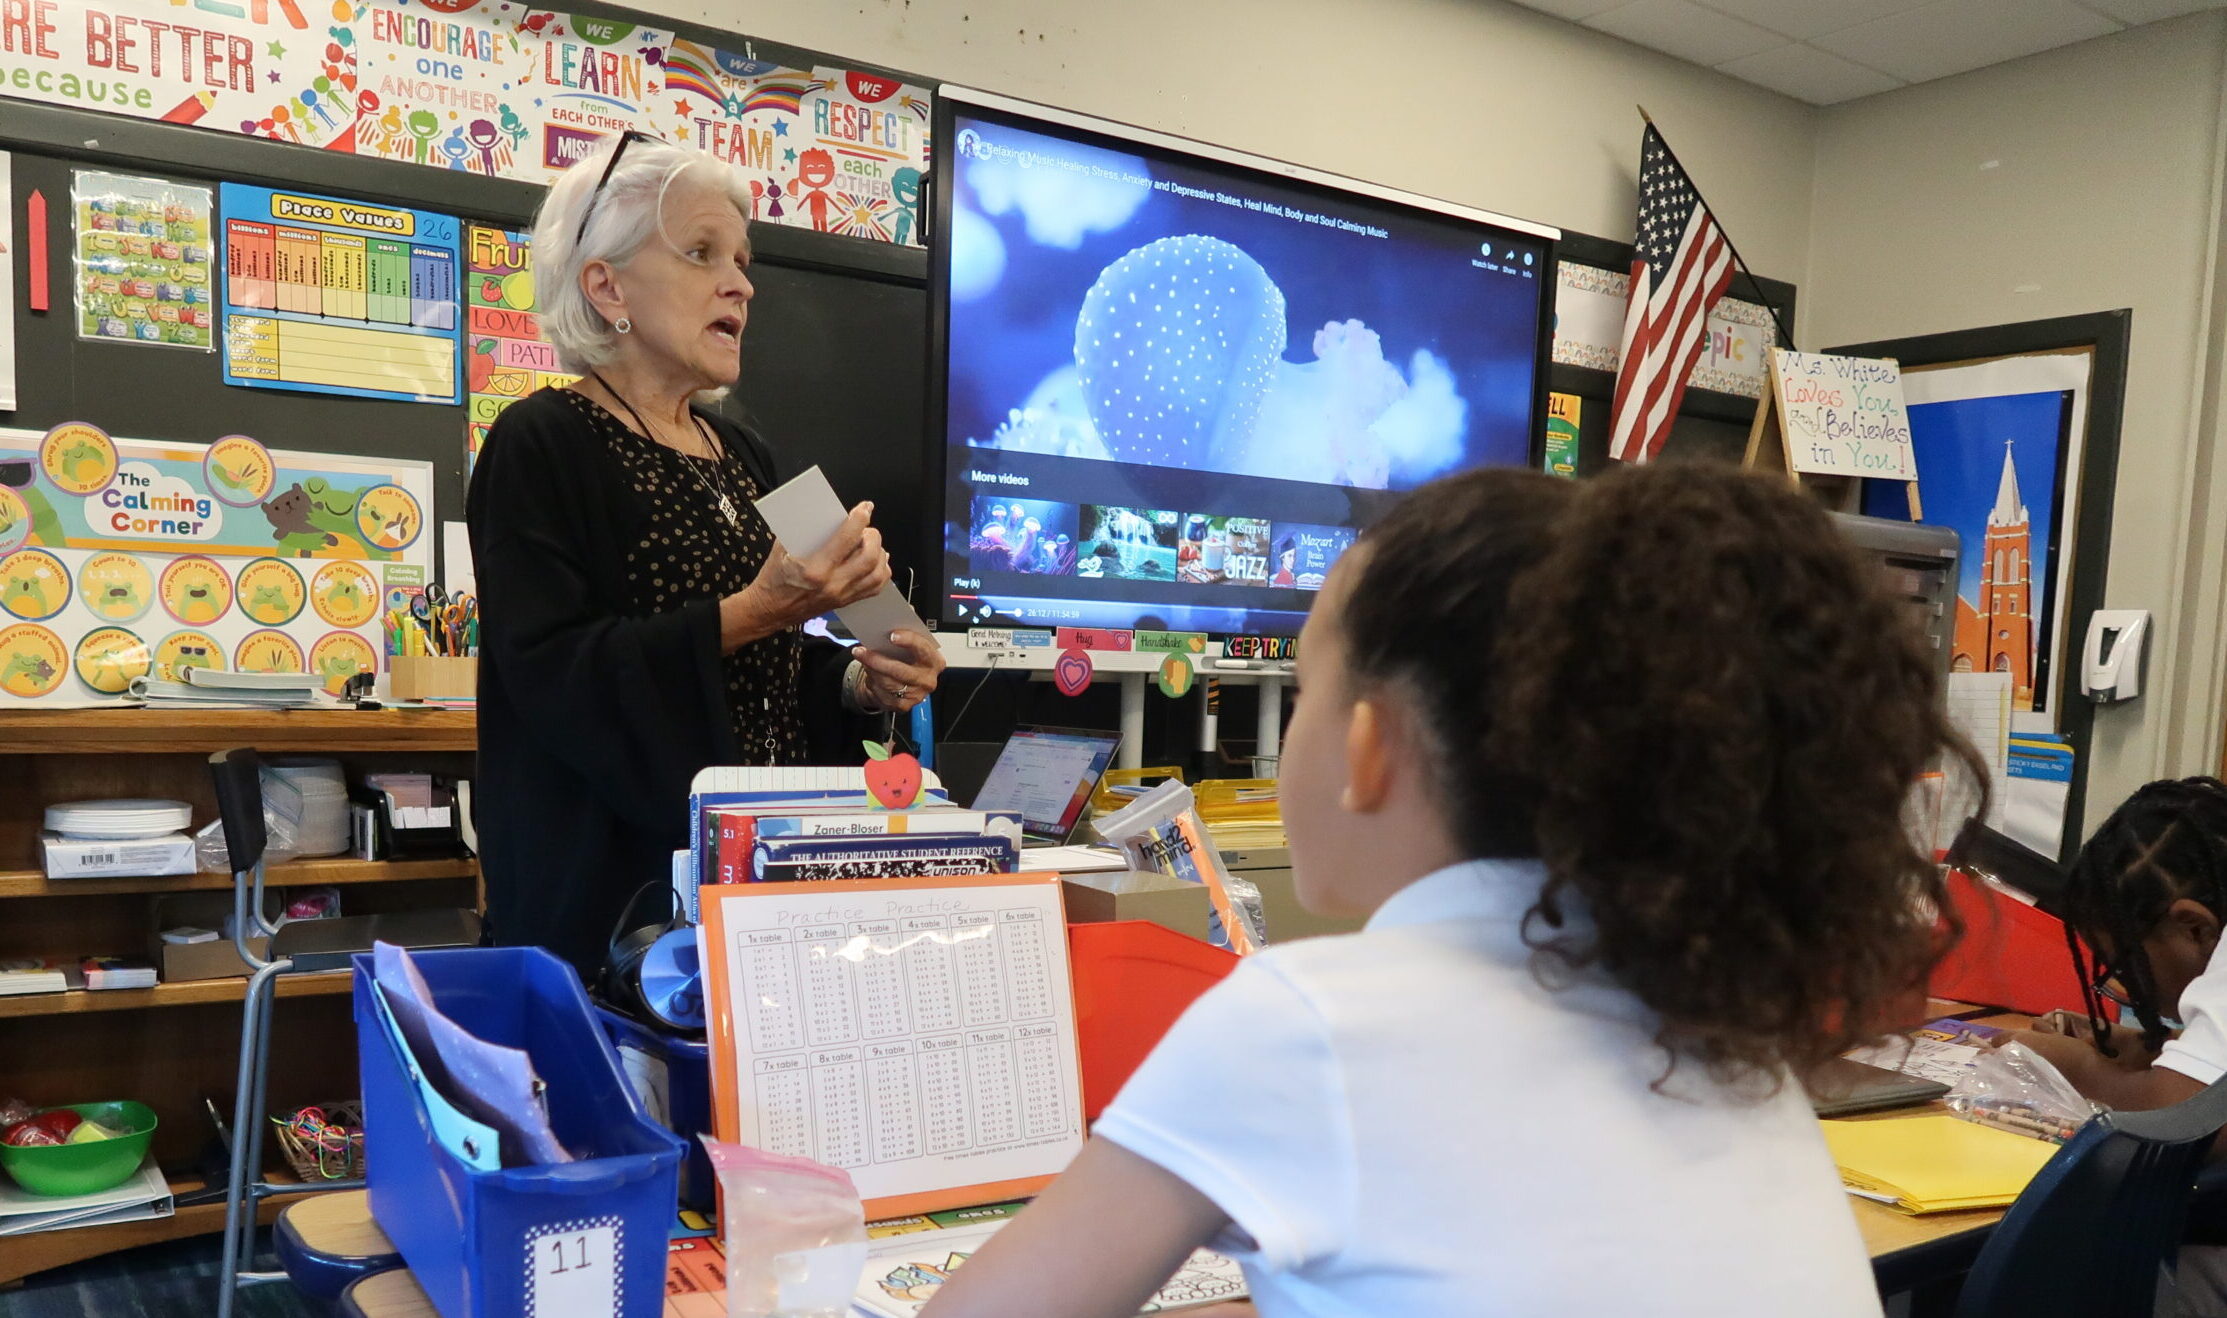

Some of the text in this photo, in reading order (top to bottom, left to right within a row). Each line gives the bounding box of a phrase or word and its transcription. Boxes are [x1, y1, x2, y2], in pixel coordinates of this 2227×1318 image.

[373, 9, 504, 65] ENCOURAGE
[586, 23, 613, 40] WE
[86, 9, 254, 93] BETTER
[416, 56, 463, 80] one
[544, 40, 641, 101] LEARN
[729, 58, 755, 73] WE
[722, 75, 747, 91] are
[857, 81, 883, 97] WE
[380, 75, 500, 114] ANOTHER
[580, 100, 608, 114] from
[729, 102, 738, 114] a
[552, 108, 635, 131] EACH OTHER'S
[814, 97, 913, 152] RESPECT
[694, 116, 773, 171] TEAM
[843, 156, 883, 179] each
[833, 172, 892, 200] OTHER
[987, 142, 1389, 239] Relaxing Music Healing Stress, Anxiety and Depressive States, Heal Mind, Body and Soul Calming Music
[280, 199, 404, 231] Place Values
[422, 218, 453, 241] 26
[474, 309, 536, 336] LOVE
[1829, 356, 1896, 384] White
[1785, 377, 1843, 408] Loves
[1827, 409, 1909, 444] Believes
[1811, 442, 1835, 464] in
[118, 472, 150, 487] The
[971, 470, 1029, 486] More videos
[102, 488, 211, 519] Calming
[110, 512, 204, 535] Corner
[1226, 523, 1269, 536] POSITIVE
[1301, 533, 1334, 550] Mozart
[92, 556, 115, 568] Count
[1225, 555, 1267, 580] JAZZ
[1306, 560, 1326, 569] Power
[953, 577, 968, 588] Play
[1075, 632, 1094, 648] Hug
[1141, 633, 1182, 649] Handshake
[1224, 636, 1261, 657] KEEP
[814, 823, 884, 835] Zaner-Bloser
[790, 846, 1003, 862] THE AUTHORITATIVE STUDENT REFERENCE
[933, 866, 977, 875] unison
[776, 904, 864, 926] Practice
[957, 915, 989, 925] 5x table
[1005, 911, 1035, 920] 6x table
[856, 924, 890, 934] 3x table
[908, 919, 941, 928] 4x table
[748, 933, 782, 944] 1x table
[803, 928, 837, 939] 2x table
[971, 1032, 1005, 1043] 11x table
[1018, 1026, 1052, 1037] 12x table
[872, 1045, 905, 1056] 9x table
[921, 1038, 958, 1050] 10x table
[762, 1059, 799, 1070] 7x table
[819, 1052, 853, 1063] 8x table
[957, 1208, 1006, 1218] ones
[550, 1236, 592, 1274] 11
